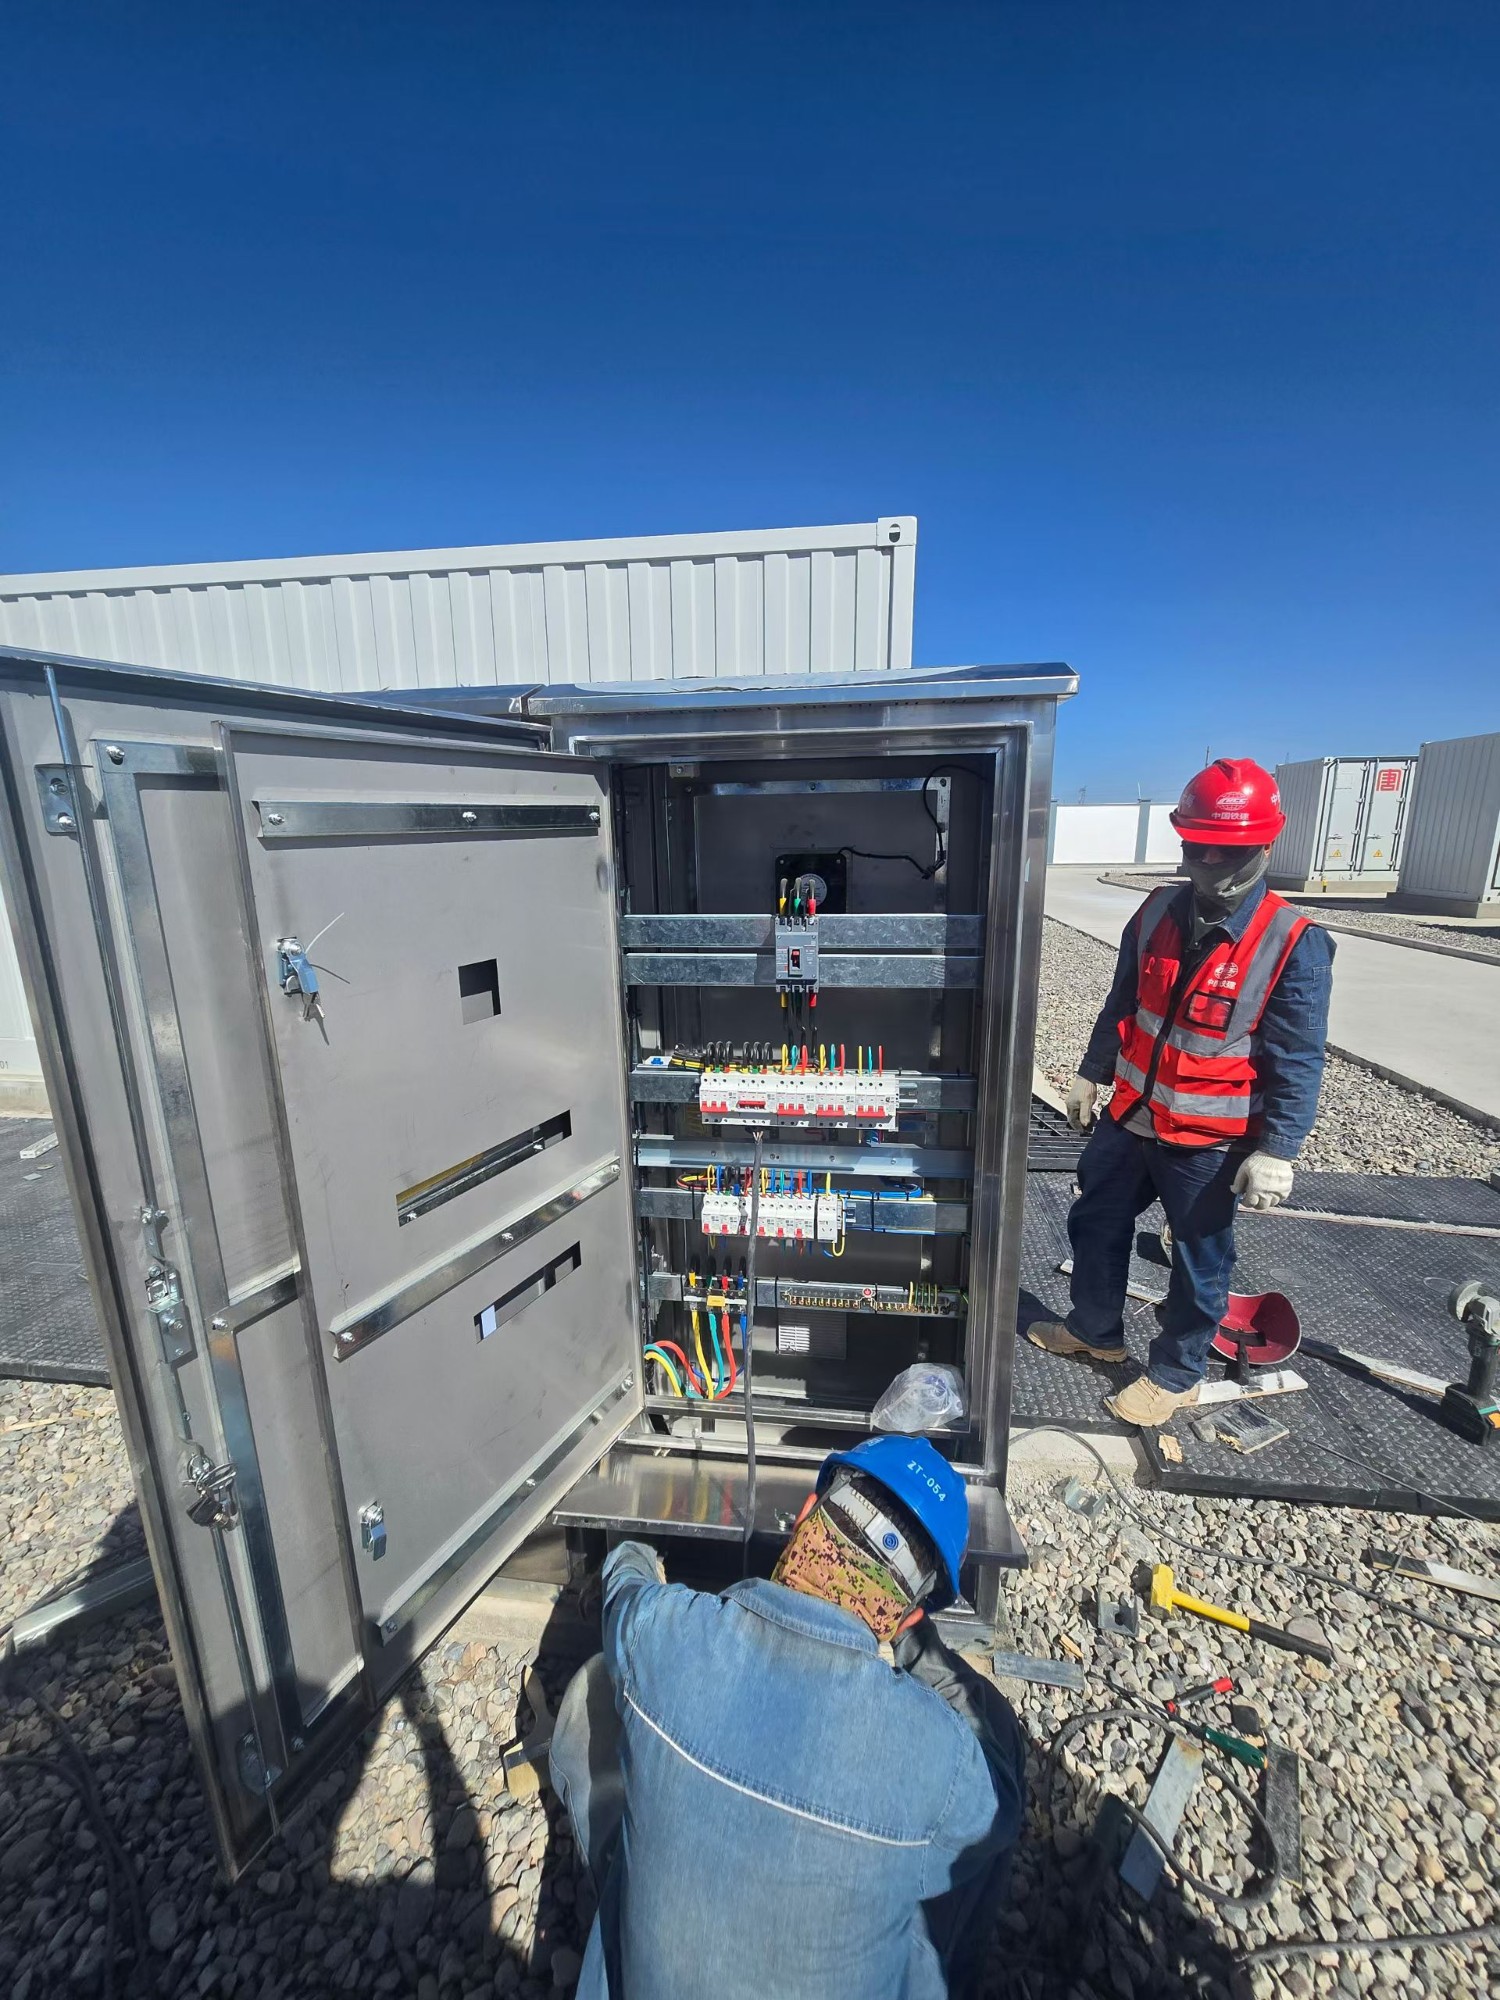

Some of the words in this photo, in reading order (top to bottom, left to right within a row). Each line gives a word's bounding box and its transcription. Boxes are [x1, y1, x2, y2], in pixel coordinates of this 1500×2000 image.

[1211, 812, 1250, 821] 中国铁建
[907, 1460, 946, 1502] ZT-054
